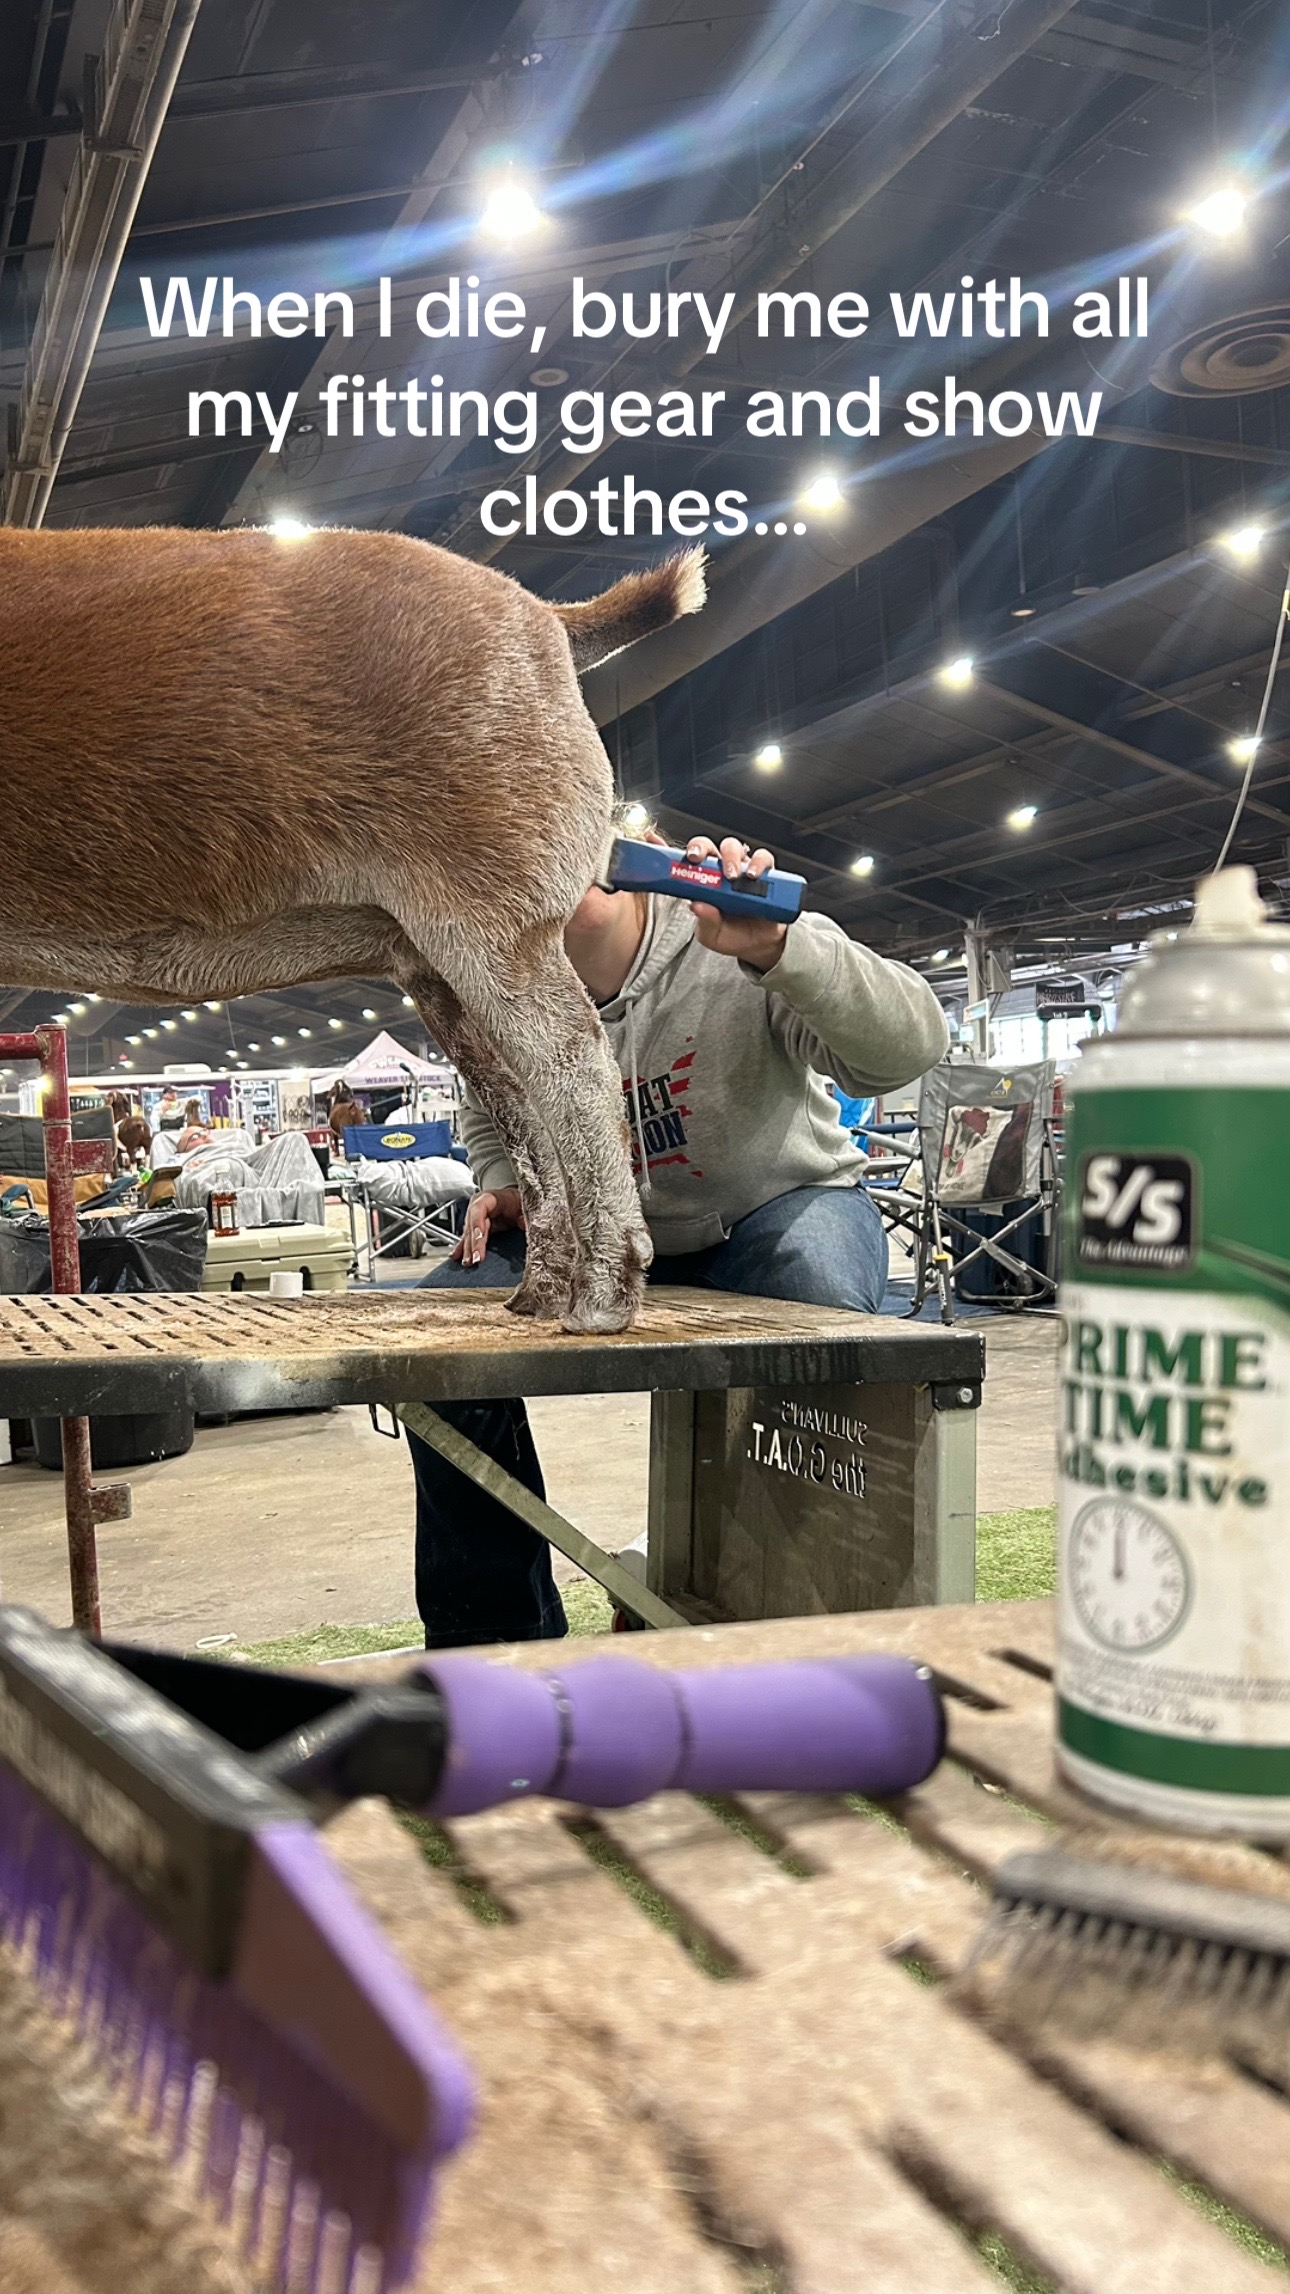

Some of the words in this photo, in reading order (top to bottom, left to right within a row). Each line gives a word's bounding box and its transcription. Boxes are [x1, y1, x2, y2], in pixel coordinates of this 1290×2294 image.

[671, 864, 721, 885] Heiniger
[365, 1075, 398, 1084] WEAVER
[1059, 1316, 1267, 1392] RIME
[1063, 1377, 1233, 1456] TIME
[1060, 1438, 1269, 1507] dhesive
